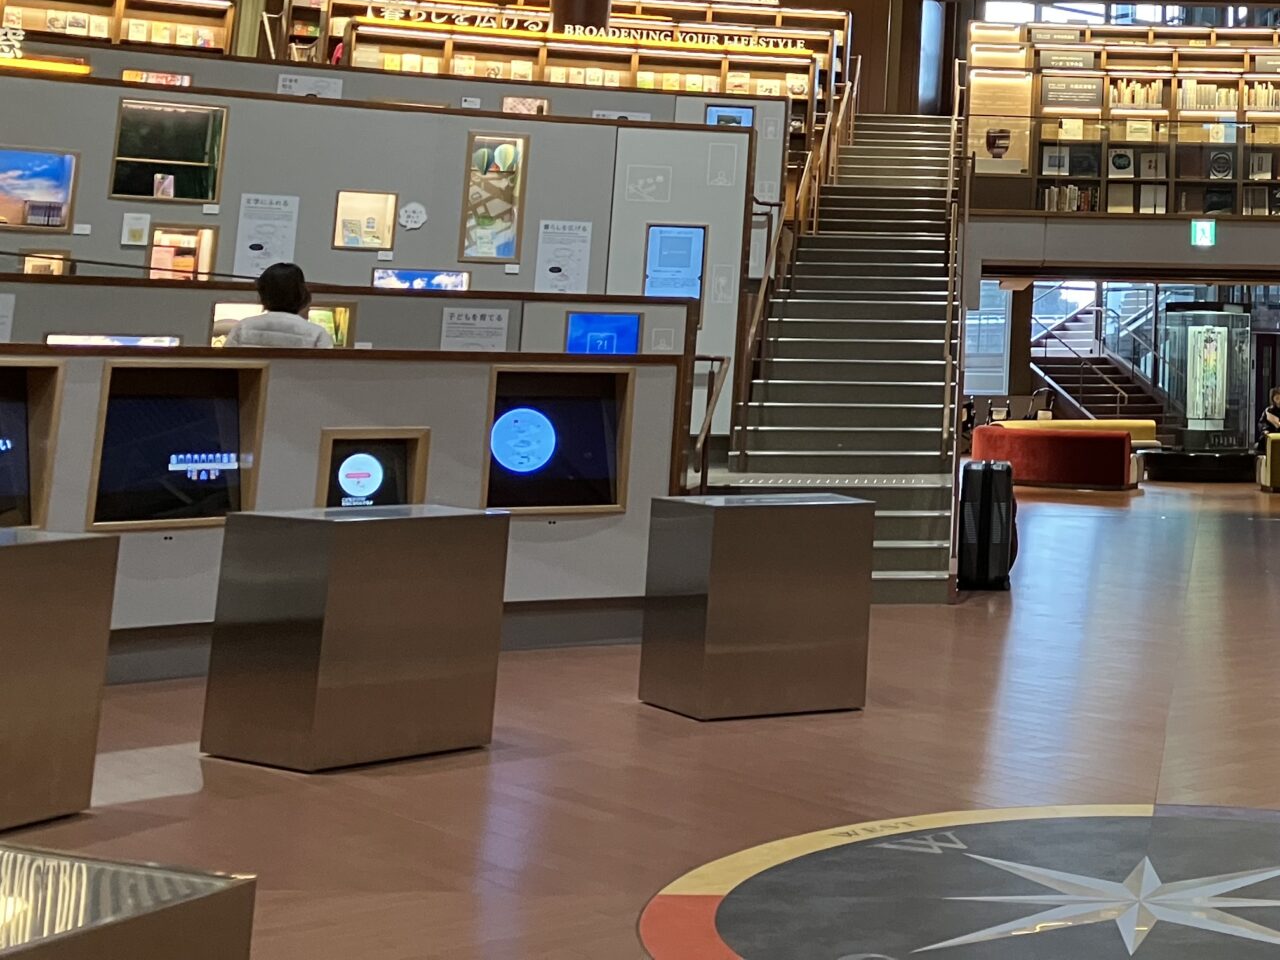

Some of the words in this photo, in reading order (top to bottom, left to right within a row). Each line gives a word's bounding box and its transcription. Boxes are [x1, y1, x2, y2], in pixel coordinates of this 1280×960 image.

[563, 24, 673, 42] BROADENING
[676, 32, 720, 46] YOUR
[723, 35, 806, 51] LIFESTYLE
[865, 830, 969, 854] W
